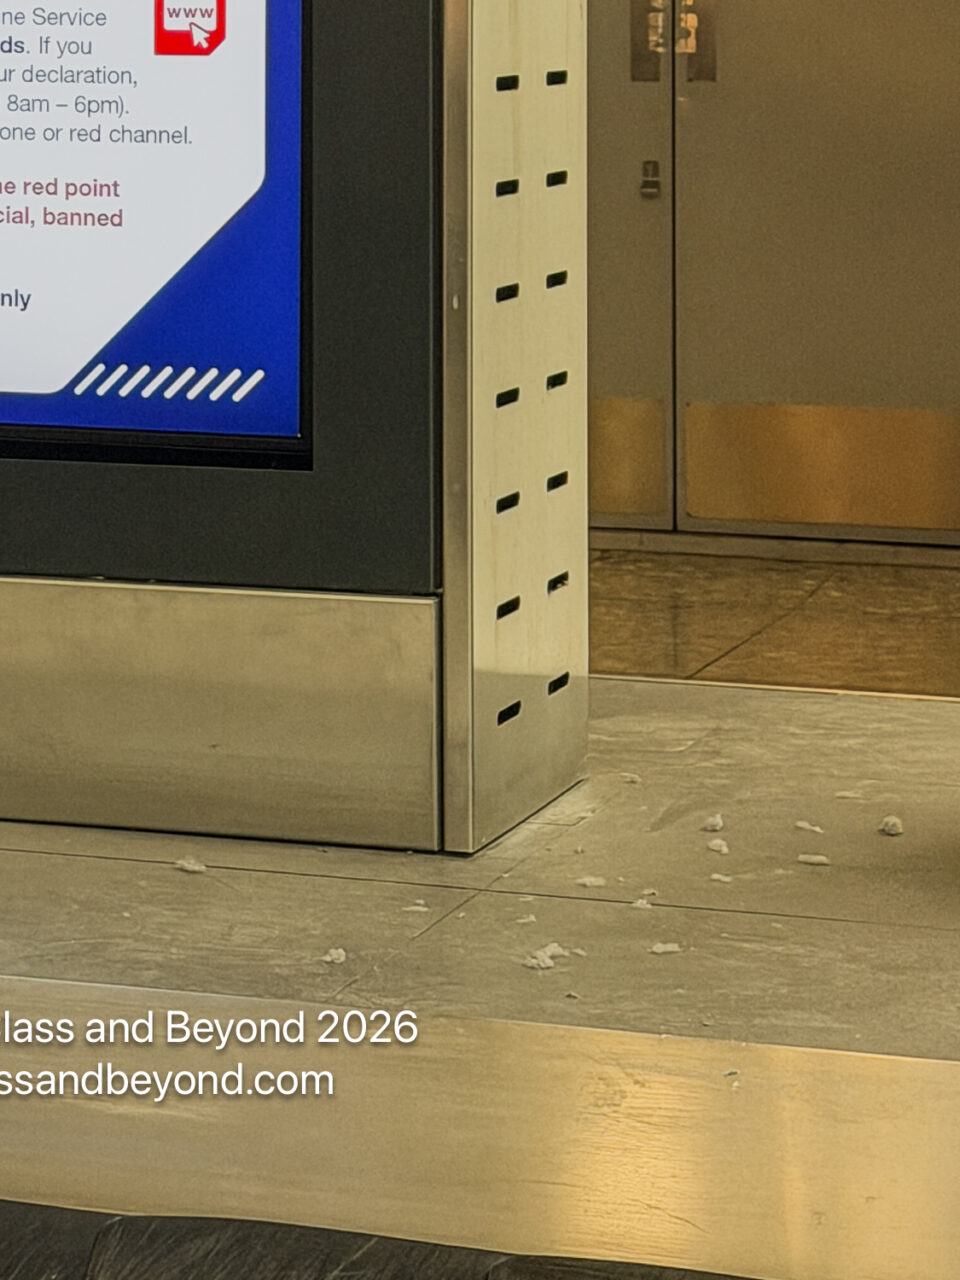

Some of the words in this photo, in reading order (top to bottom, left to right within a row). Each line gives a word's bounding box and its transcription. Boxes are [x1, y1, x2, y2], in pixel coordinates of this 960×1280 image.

[40, 35, 51, 55] If
[56, 40, 92, 59] you
[7, 94, 49, 113] 8am
[75, 95, 129, 119] 6pm).
[43, 206, 122, 228] banned
